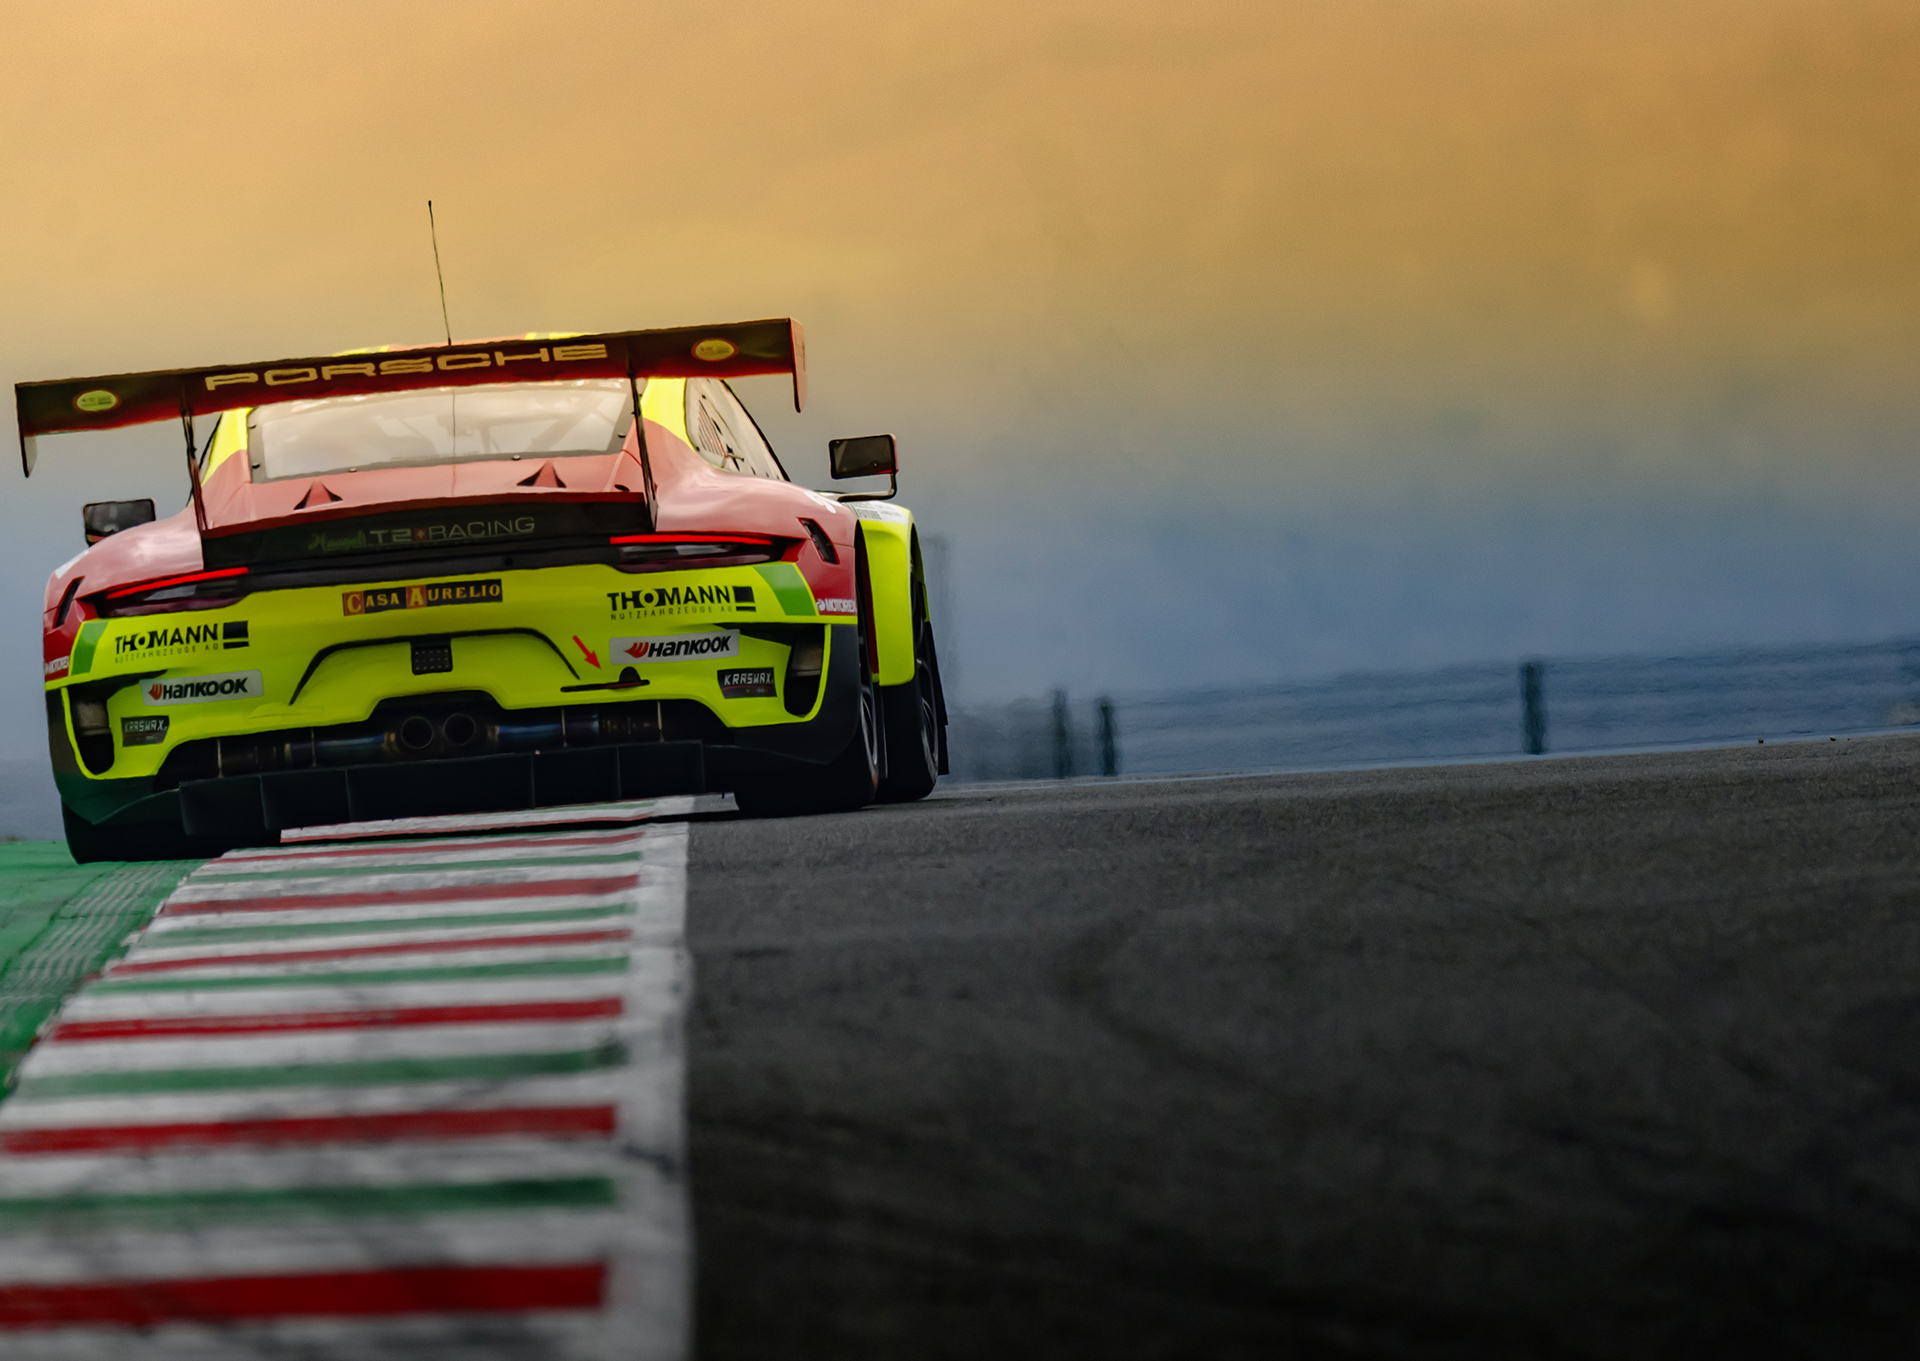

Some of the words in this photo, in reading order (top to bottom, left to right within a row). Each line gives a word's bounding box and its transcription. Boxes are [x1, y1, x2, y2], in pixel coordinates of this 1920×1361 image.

[205, 344, 608, 391] PORSCHE
[428, 517, 535, 541] RACING
[607, 586, 730, 611] THOMANN
[611, 605, 713, 620] NUTZFAHRZEUGE
[114, 623, 218, 654] THOMANN
[114, 646, 196, 664] NUTZFAHRZEUGE
[205, 642, 219, 651] AG
[724, 672, 772, 685] KRASWAX
